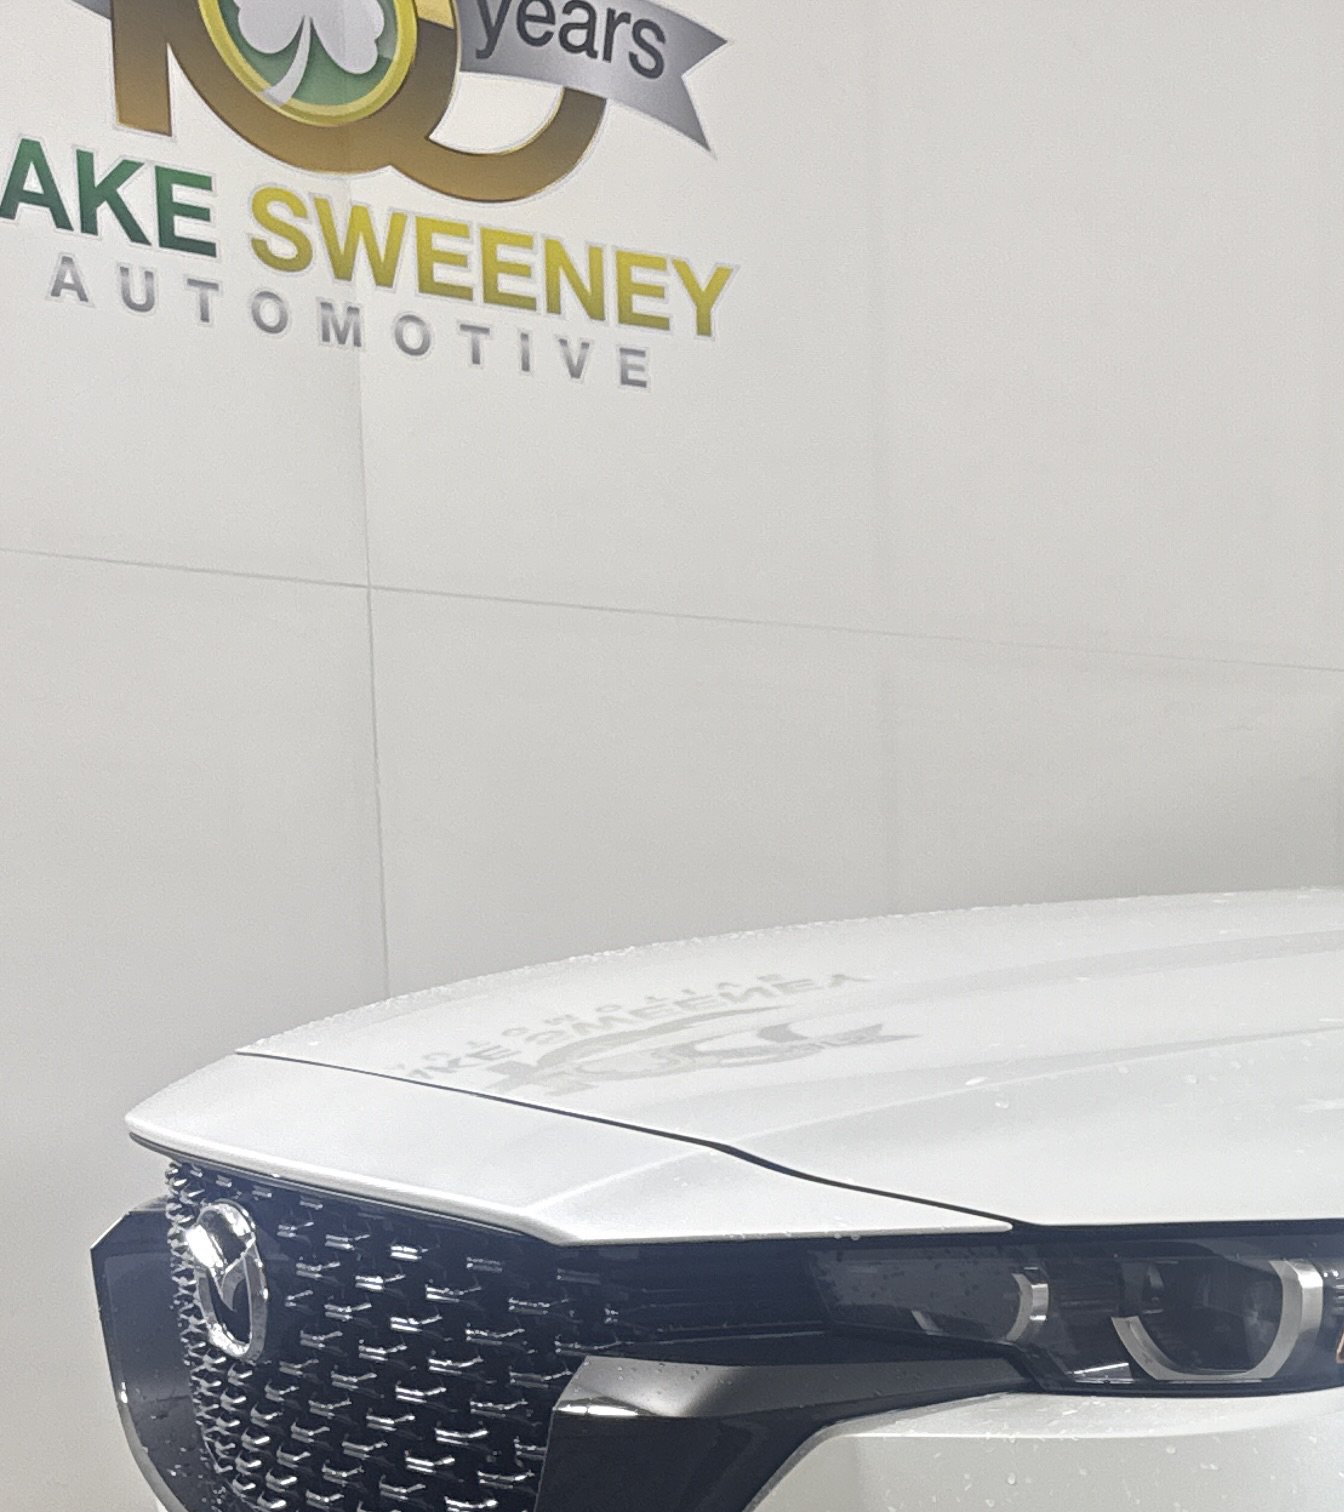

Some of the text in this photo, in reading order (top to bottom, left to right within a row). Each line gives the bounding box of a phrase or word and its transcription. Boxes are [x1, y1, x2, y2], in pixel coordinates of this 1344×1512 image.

[474, 0, 666, 80] years
[0, 137, 733, 338] AKE SWEENEY
[49, 256, 649, 388] AUTOMOTIVE
